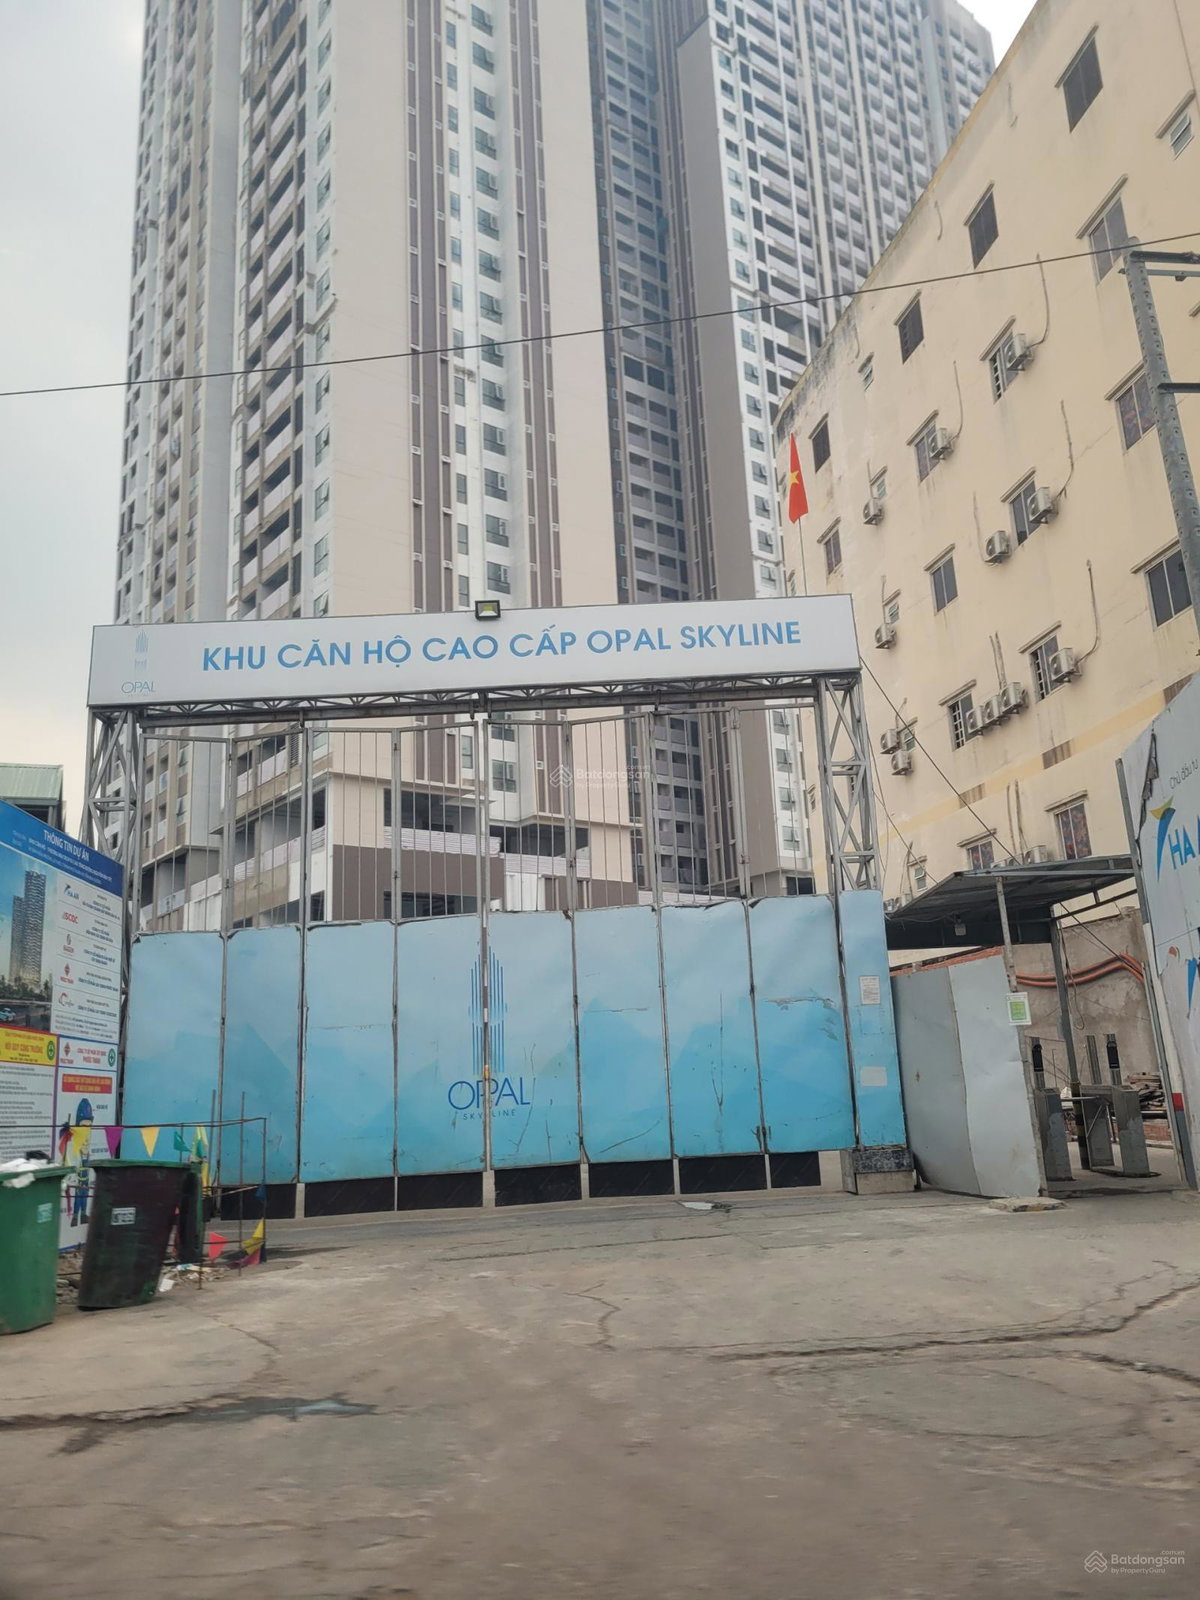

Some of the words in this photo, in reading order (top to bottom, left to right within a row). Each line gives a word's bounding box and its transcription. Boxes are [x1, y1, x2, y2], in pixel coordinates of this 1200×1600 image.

[203, 645, 266, 671] KHU
[277, 639, 351, 669] CĂN
[363, 635, 412, 668] HỘ
[422, 635, 499, 662] CAO
[509, 624, 577, 657] CẤP
[586, 627, 672, 654] OPAL
[680, 621, 801, 649] SKYLINE
[121, 681, 156, 694] OPAL
[448, 1077, 531, 1110] OPAL
